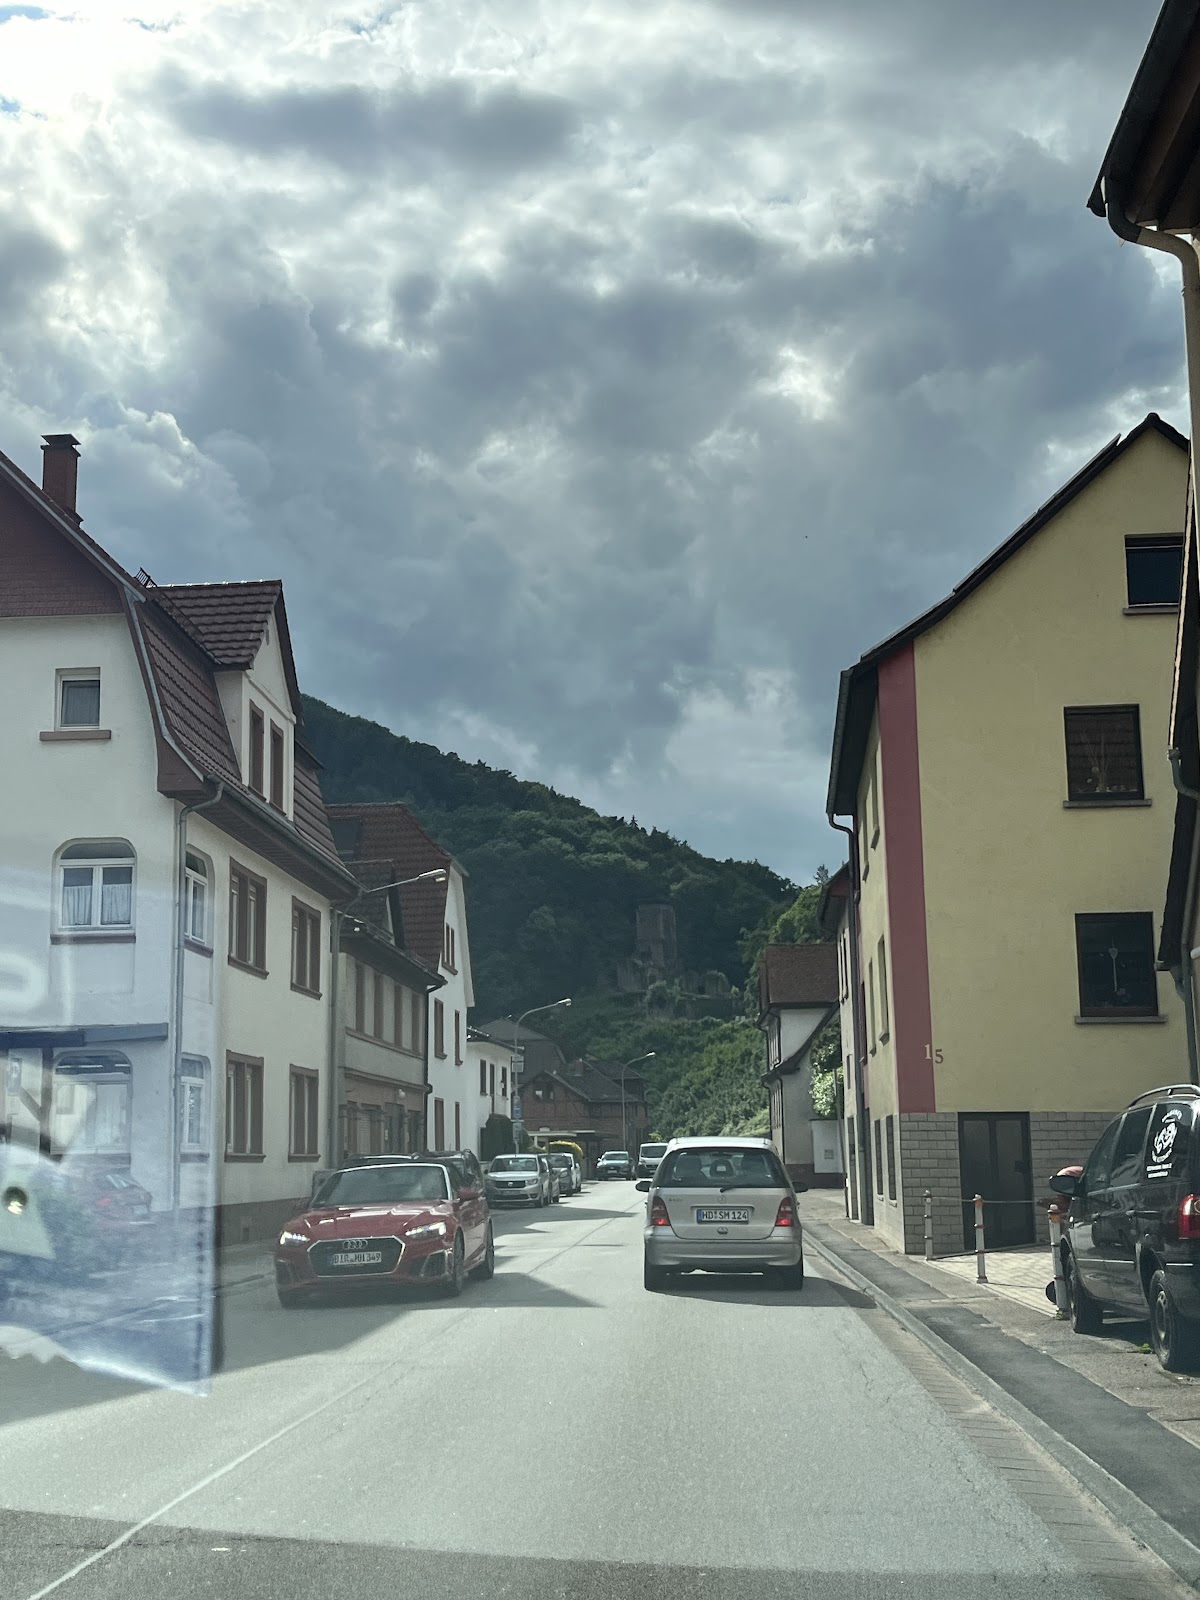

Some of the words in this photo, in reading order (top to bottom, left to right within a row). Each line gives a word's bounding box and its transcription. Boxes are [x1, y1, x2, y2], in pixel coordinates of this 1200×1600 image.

[924, 1044, 944, 1064] 15
[702, 1210, 714, 1220] HD
[718, 1210, 730, 1220] SM
[731, 1210, 747, 1220] 124
